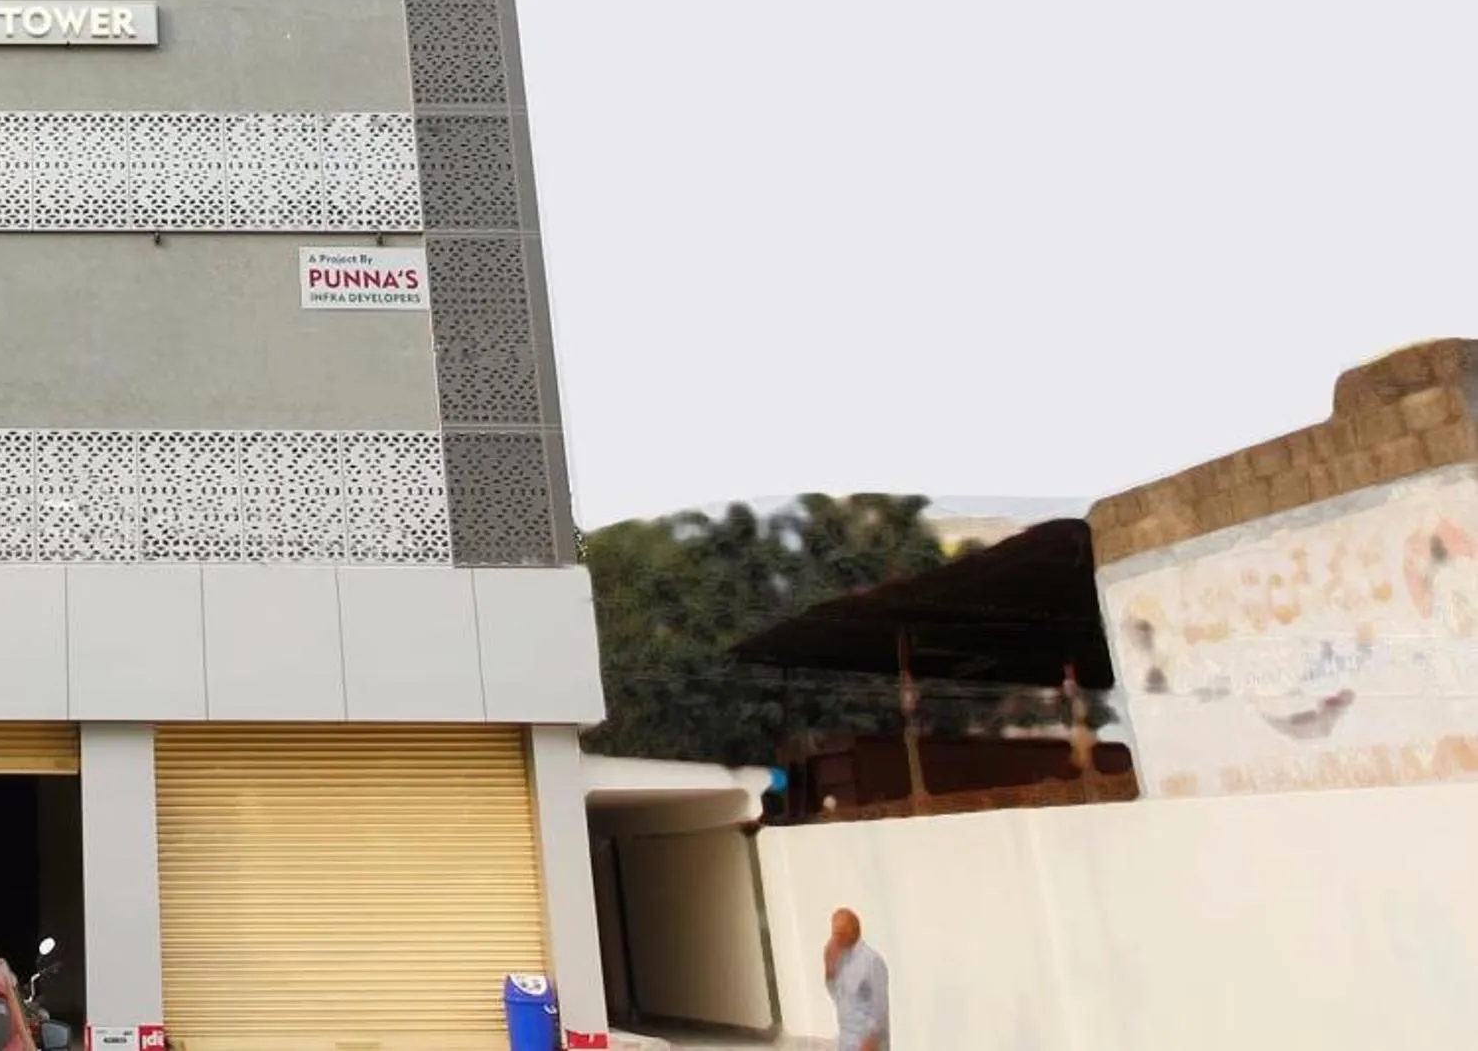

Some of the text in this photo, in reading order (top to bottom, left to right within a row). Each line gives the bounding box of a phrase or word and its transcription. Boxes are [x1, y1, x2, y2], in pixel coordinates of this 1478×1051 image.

[308, 254, 373, 265] A Project By
[308, 269, 419, 289] PUNNA'S
[310, 293, 421, 304] INFRA DEVELOPERS
